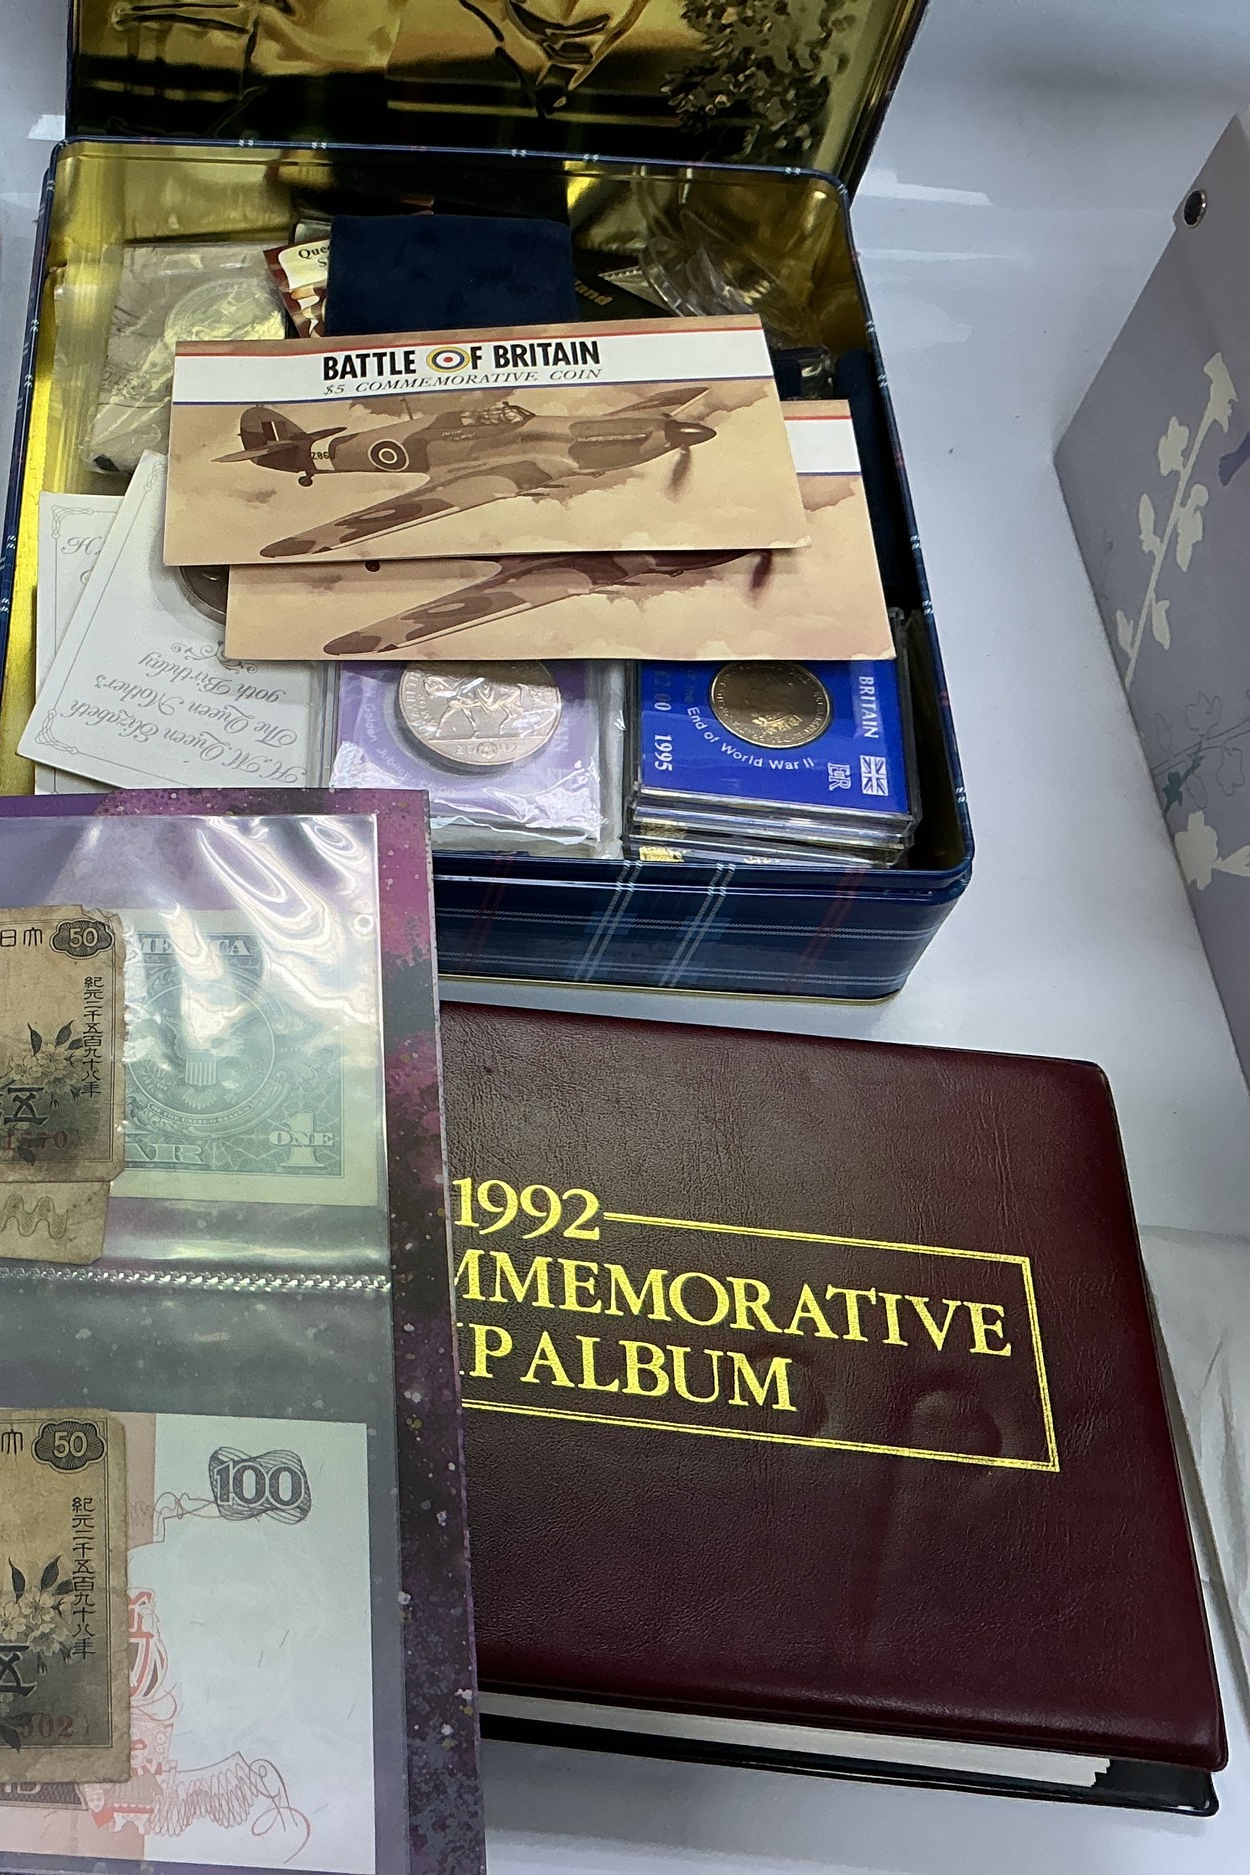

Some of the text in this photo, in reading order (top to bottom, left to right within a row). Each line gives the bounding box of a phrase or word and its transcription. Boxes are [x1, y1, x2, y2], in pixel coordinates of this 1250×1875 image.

[323, 350, 416, 381] BATTLE
[492, 341, 601, 369] BRITAIN
[323, 369, 602, 395] $5 COMMEMORATIVE COIN
[60, 535, 104, 556] H.
[138, 653, 286, 704] 90th Birthday
[61, 700, 159, 743] Elizabeth
[94, 675, 298, 748] The Queen Mother's
[859, 675, 880, 739] BRITAIN
[162, 727, 229, 762] Queen
[654, 734, 673, 772] 1995
[687, 707, 709, 731] End
[704, 731, 720, 743] of
[721, 743, 763, 768] World
[769, 760, 799, 770] War
[68, 927, 99, 948] 50
[268, 1131, 335, 1146] ONE
[452, 1177, 601, 1242] 1992
[454, 1250, 1013, 1358] MMEMORATIVE
[521, 1330, 798, 1412] ALBUM
[52, 1430, 88, 1459] 50
[215, 1458, 308, 1509] 100
